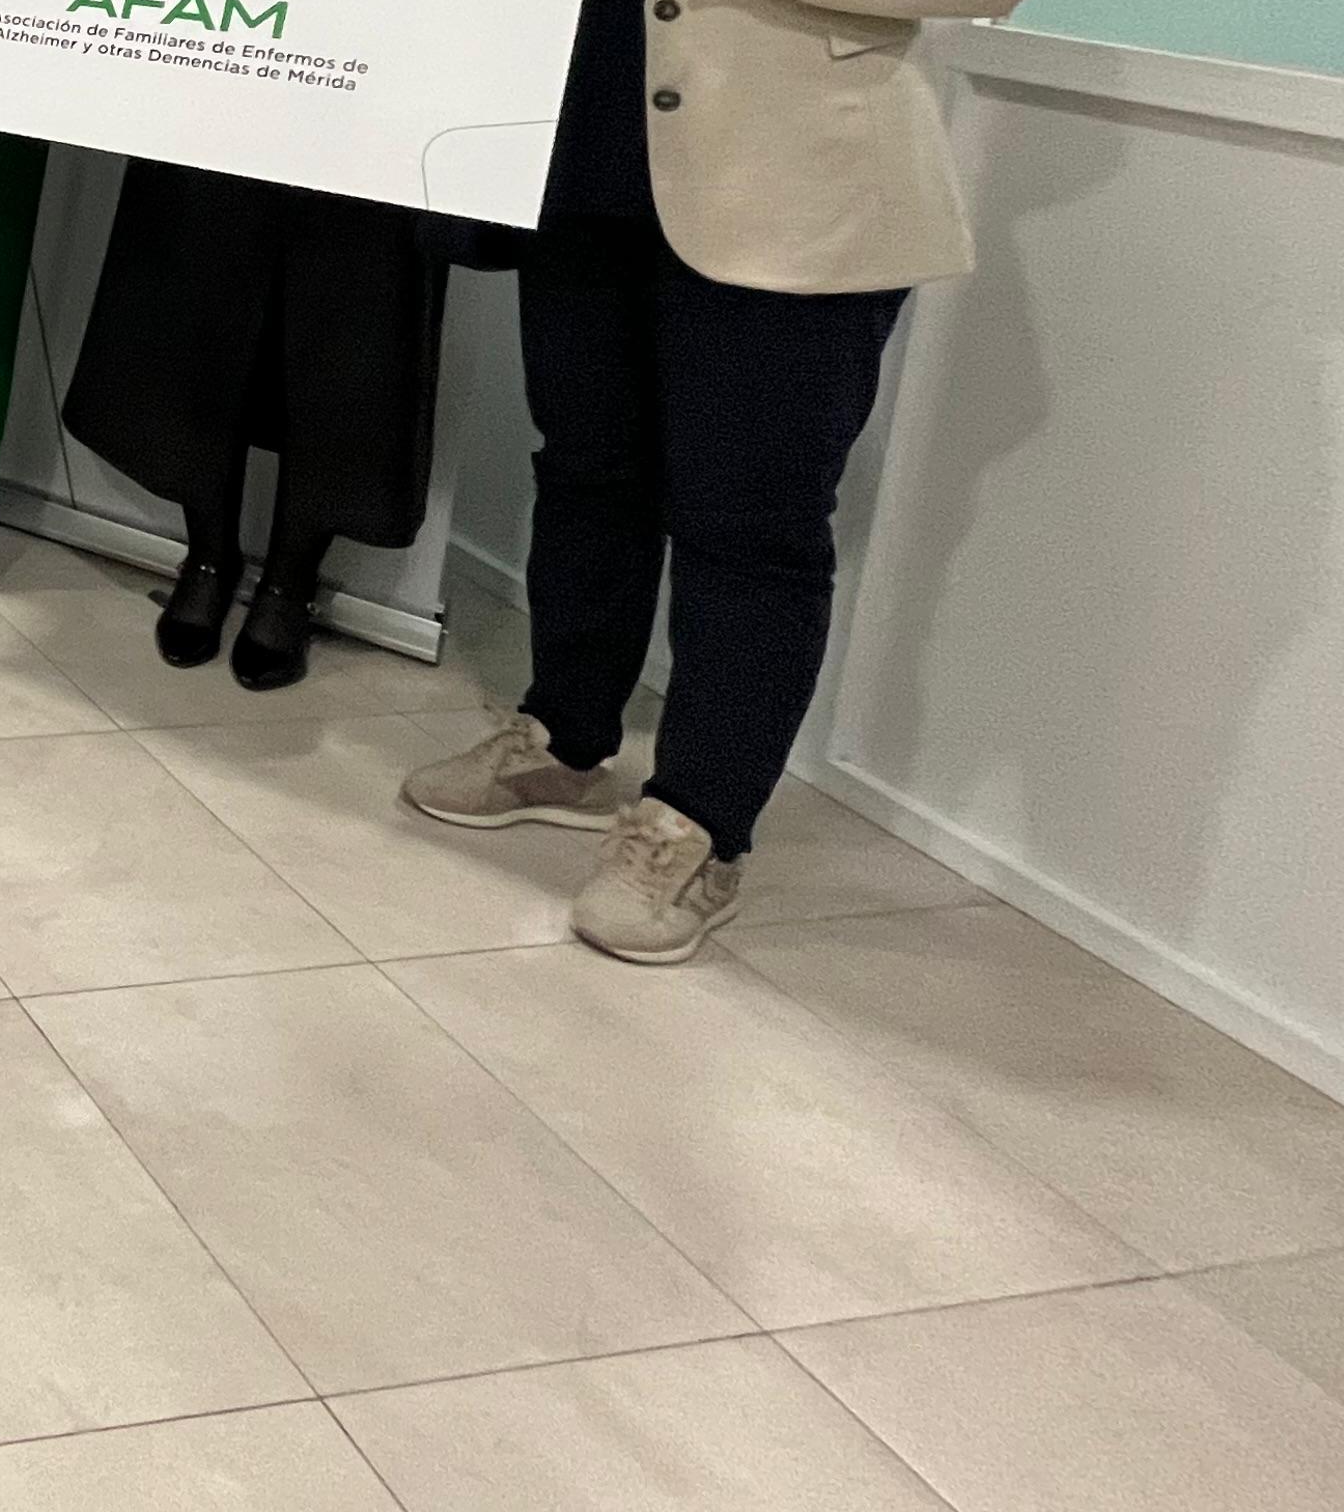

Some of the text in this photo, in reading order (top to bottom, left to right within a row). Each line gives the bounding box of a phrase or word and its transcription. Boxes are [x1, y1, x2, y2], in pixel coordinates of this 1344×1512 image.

[82, 39, 94, 55] y
[97, 41, 143, 60] otras
[147, 48, 251, 77] Demencias
[255, 63, 282, 81] de
[286, 68, 358, 92] Mérida
[86, 22, 110, 39] de
[113, 27, 206, 53] Familiares
[211, 41, 237, 57] de
[242, 44, 337, 72] Enfermos
[342, 58, 370, 76] de
